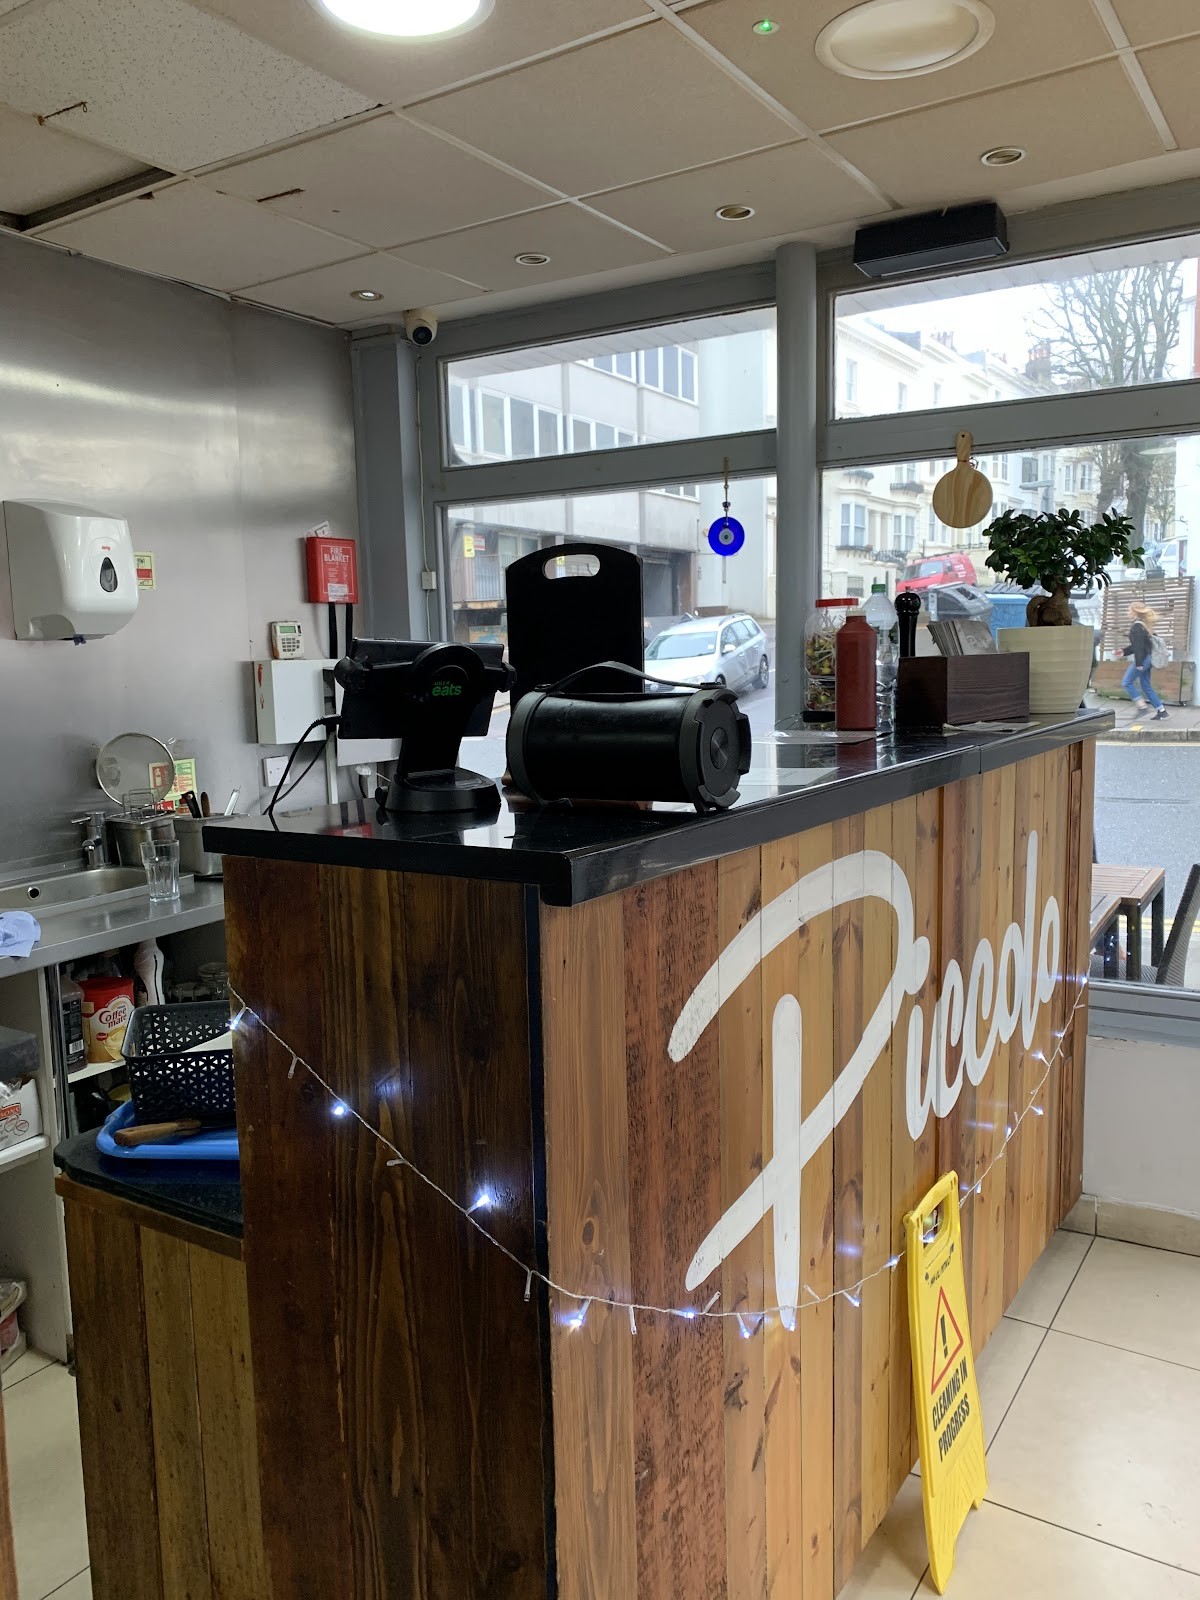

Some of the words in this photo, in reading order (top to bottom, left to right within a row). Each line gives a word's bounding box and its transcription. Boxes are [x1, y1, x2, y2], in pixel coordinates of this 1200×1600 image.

[324, 553, 350, 563] BLANKET
[330, 547, 343, 556] FIRE
[432, 683, 462, 696] eats
[99, 1007, 127, 1025] Coffee
[107, 1014, 127, 1029] mate
[667, 830, 1061, 1331] Piccolo
[932, 1368, 961, 1432] CLEANING
[959, 1356, 968, 1385] IN
[938, 1392, 970, 1462] PROGRESS
